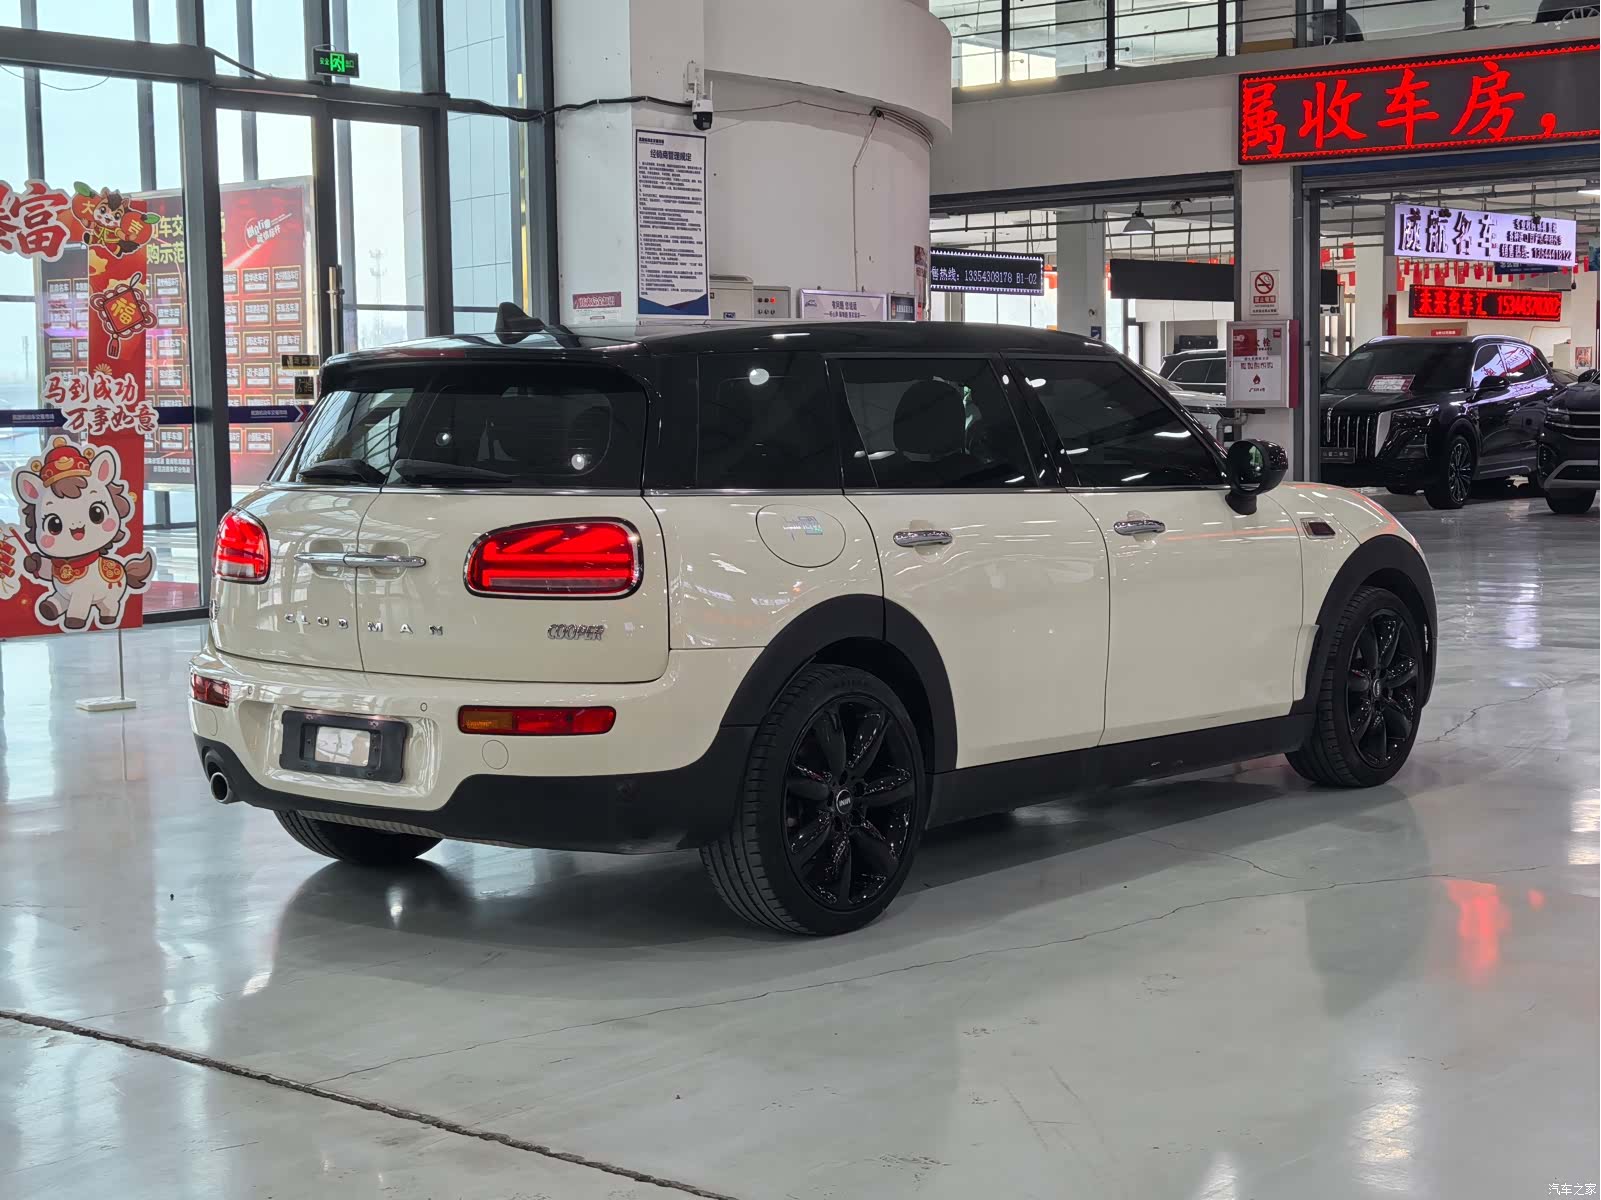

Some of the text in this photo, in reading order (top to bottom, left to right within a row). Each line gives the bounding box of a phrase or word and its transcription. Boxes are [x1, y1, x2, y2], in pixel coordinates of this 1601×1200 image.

[82, 202, 143, 234] 大 吉
[153, 214, 183, 239] 车交
[1016, 273, 1037, 285] B1-02
[111, 298, 137, 325] 福
[45, 375, 135, 403] 马到成功
[66, 404, 155, 432] 万事如意
[547, 624, 604, 641] COOPER
